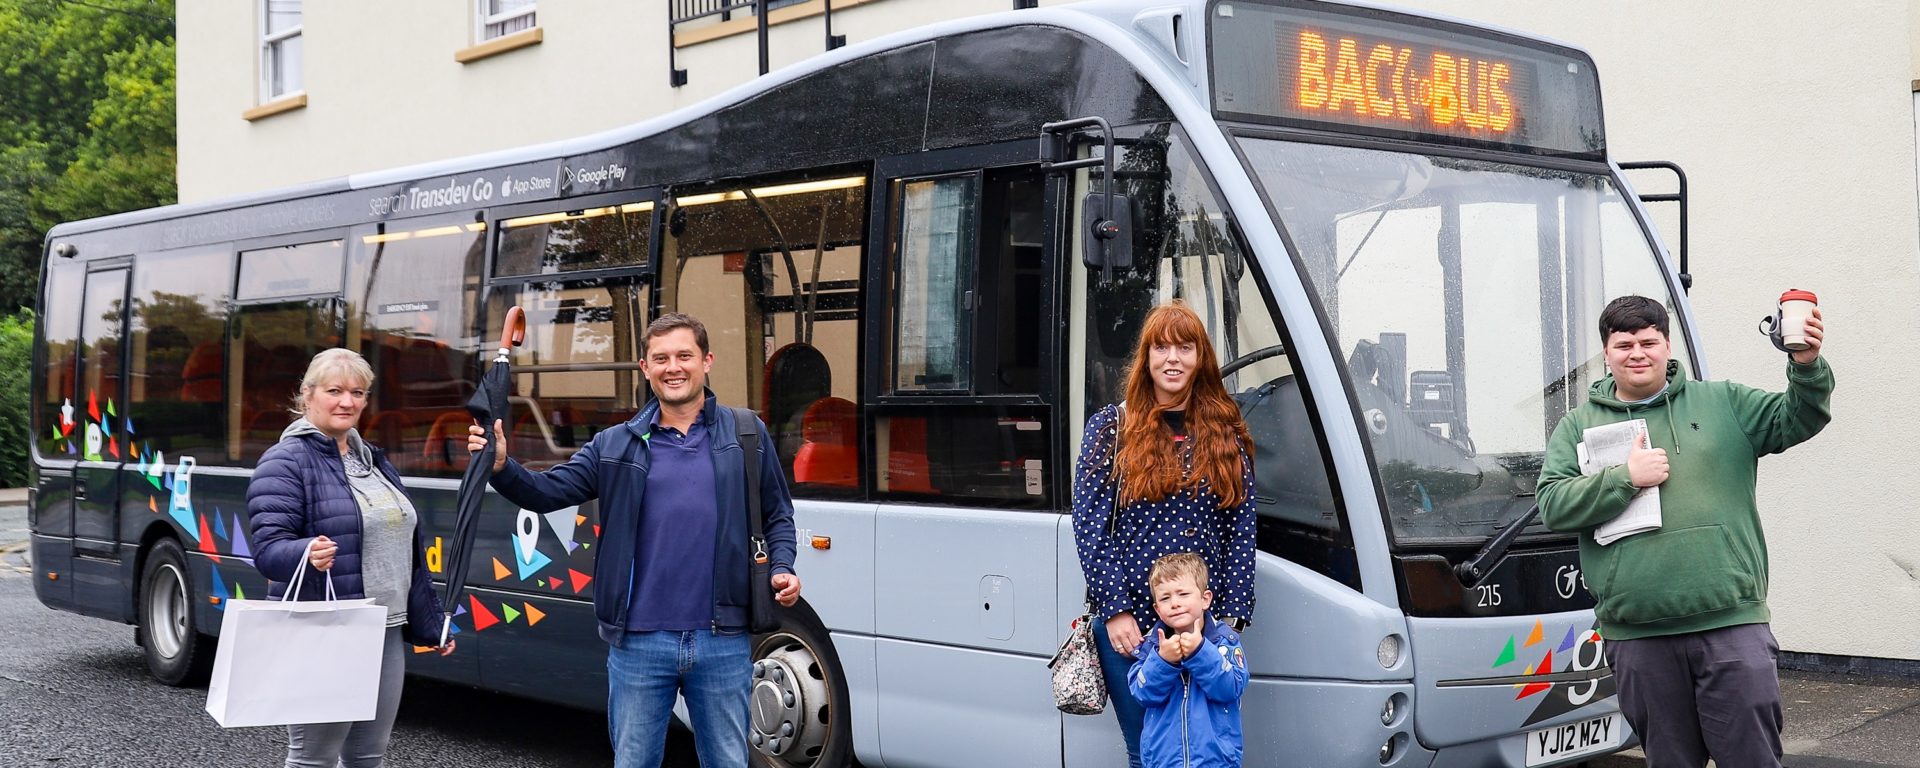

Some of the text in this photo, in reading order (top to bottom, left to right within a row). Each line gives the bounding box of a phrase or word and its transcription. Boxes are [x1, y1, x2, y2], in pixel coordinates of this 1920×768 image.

[1410, 67, 1431, 107] to
[1431, 53, 1513, 132] BUS
[512, 175, 552, 195] App Store
[577, 163, 627, 184] Google Play
[369, 175, 493, 216] search Transdev Go
[1477, 584, 1501, 607] 215
[1539, 716, 1612, 757] YJ12 MZY
